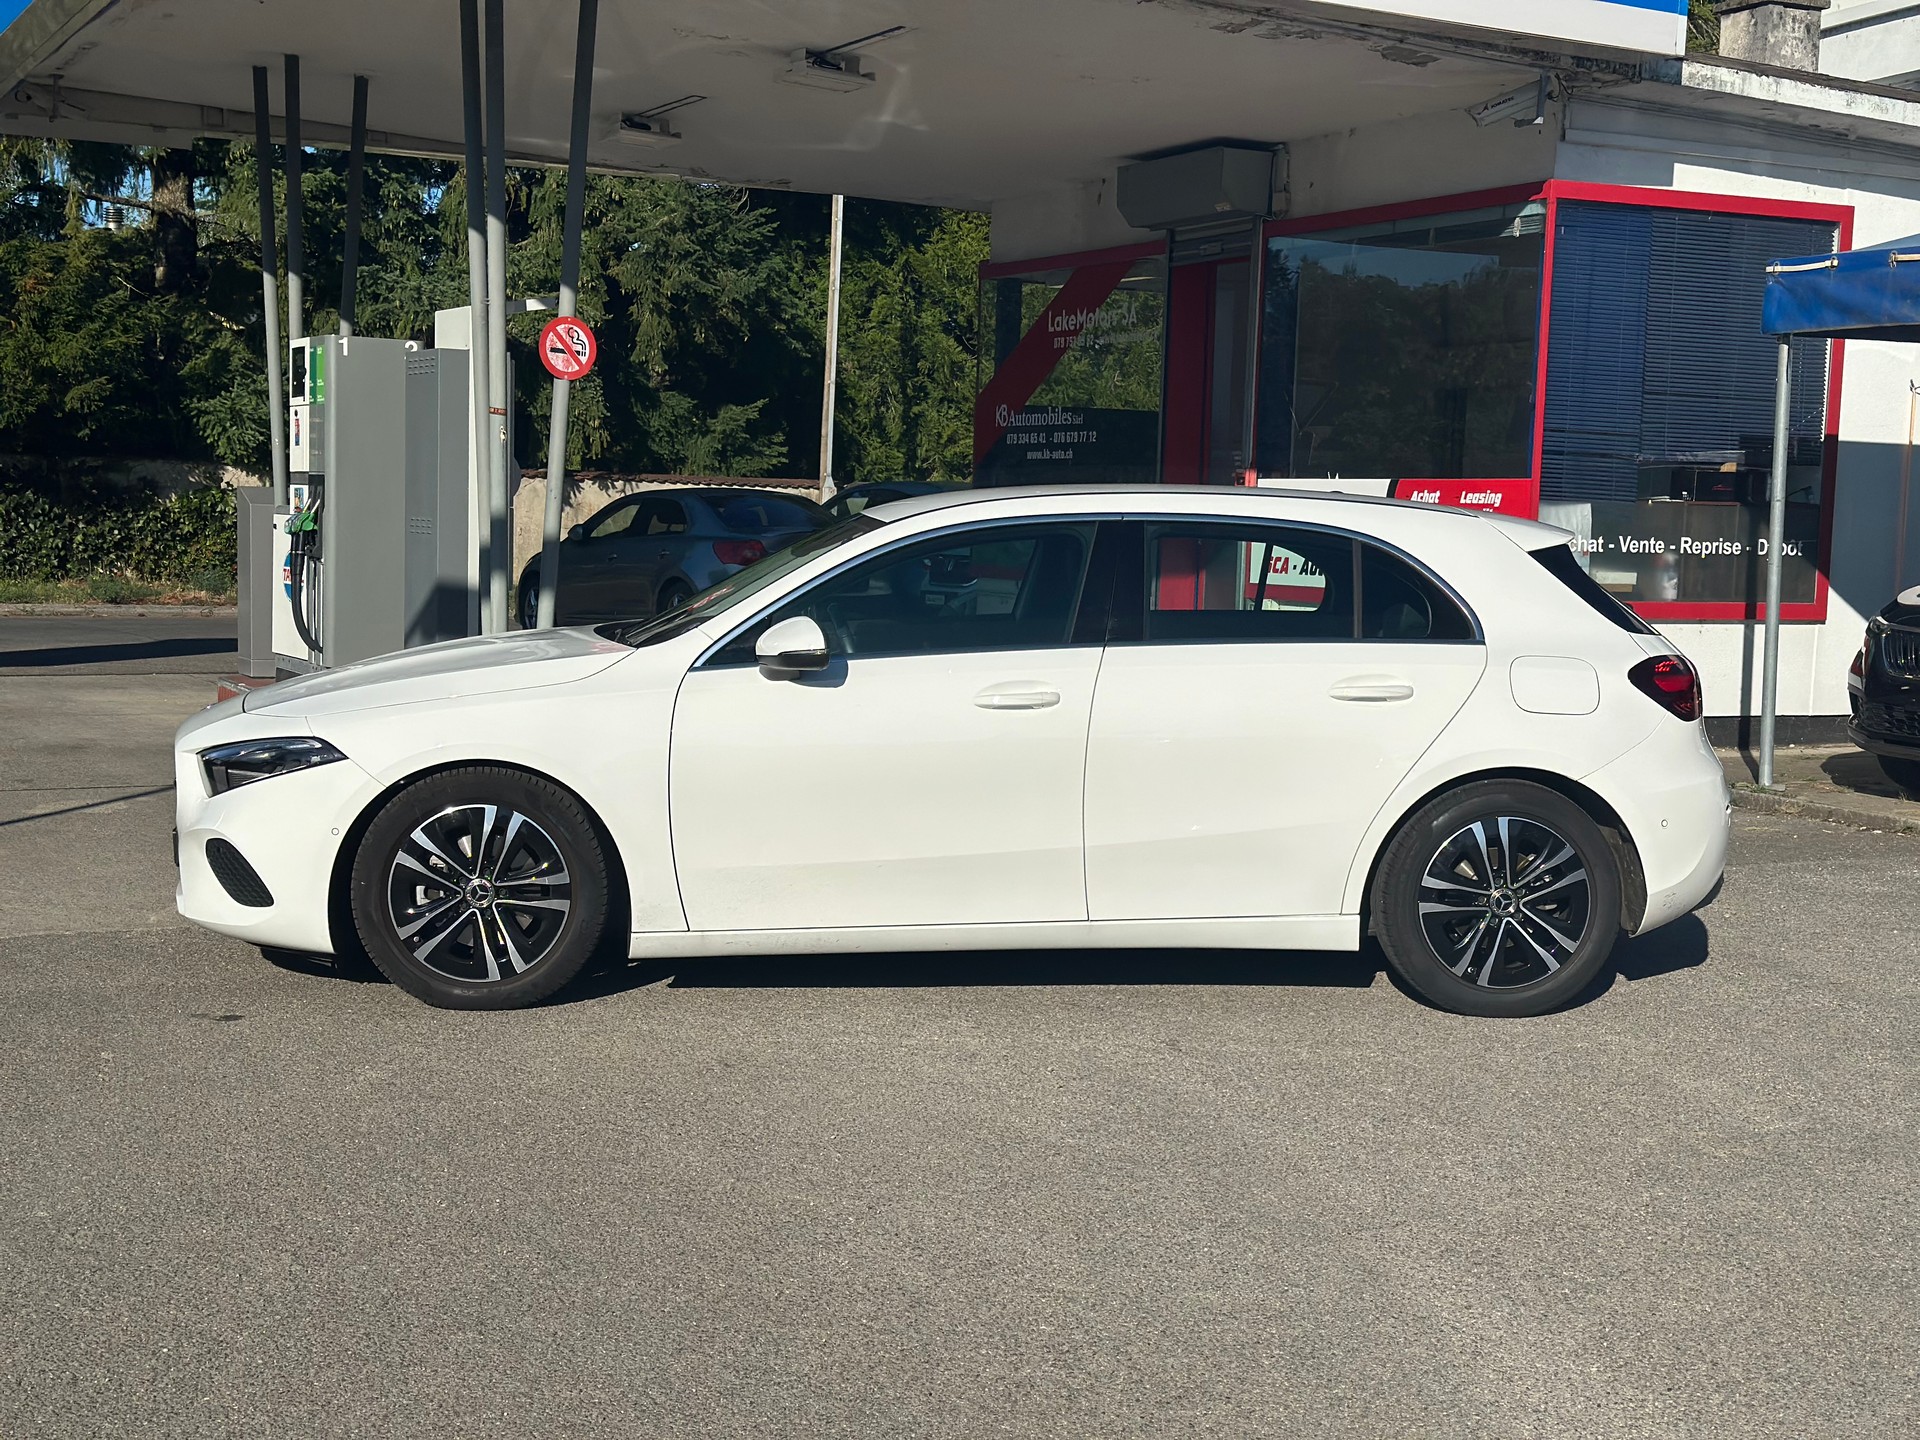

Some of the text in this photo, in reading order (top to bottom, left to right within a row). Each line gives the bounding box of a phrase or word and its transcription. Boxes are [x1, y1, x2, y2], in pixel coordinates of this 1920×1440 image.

[338, 336, 348, 356] 1
[1006, 433, 1017, 444] 079
[1018, 432, 1029, 444] 334
[1030, 432, 1038, 443] 65
[1039, 431, 1047, 443] 41
[1079, 431, 1087, 443] 77
[1089, 430, 1097, 442] 12
[1026, 448, 1073, 460] www.kb-auto.ch
[1410, 489, 1441, 504] Achat
[1459, 489, 1503, 508] Leasing
[1568, 534, 1604, 553] chat
[1618, 535, 1665, 554] Vente
[1679, 536, 1742, 559] Reprise
[1757, 538, 1803, 556] Dôt
